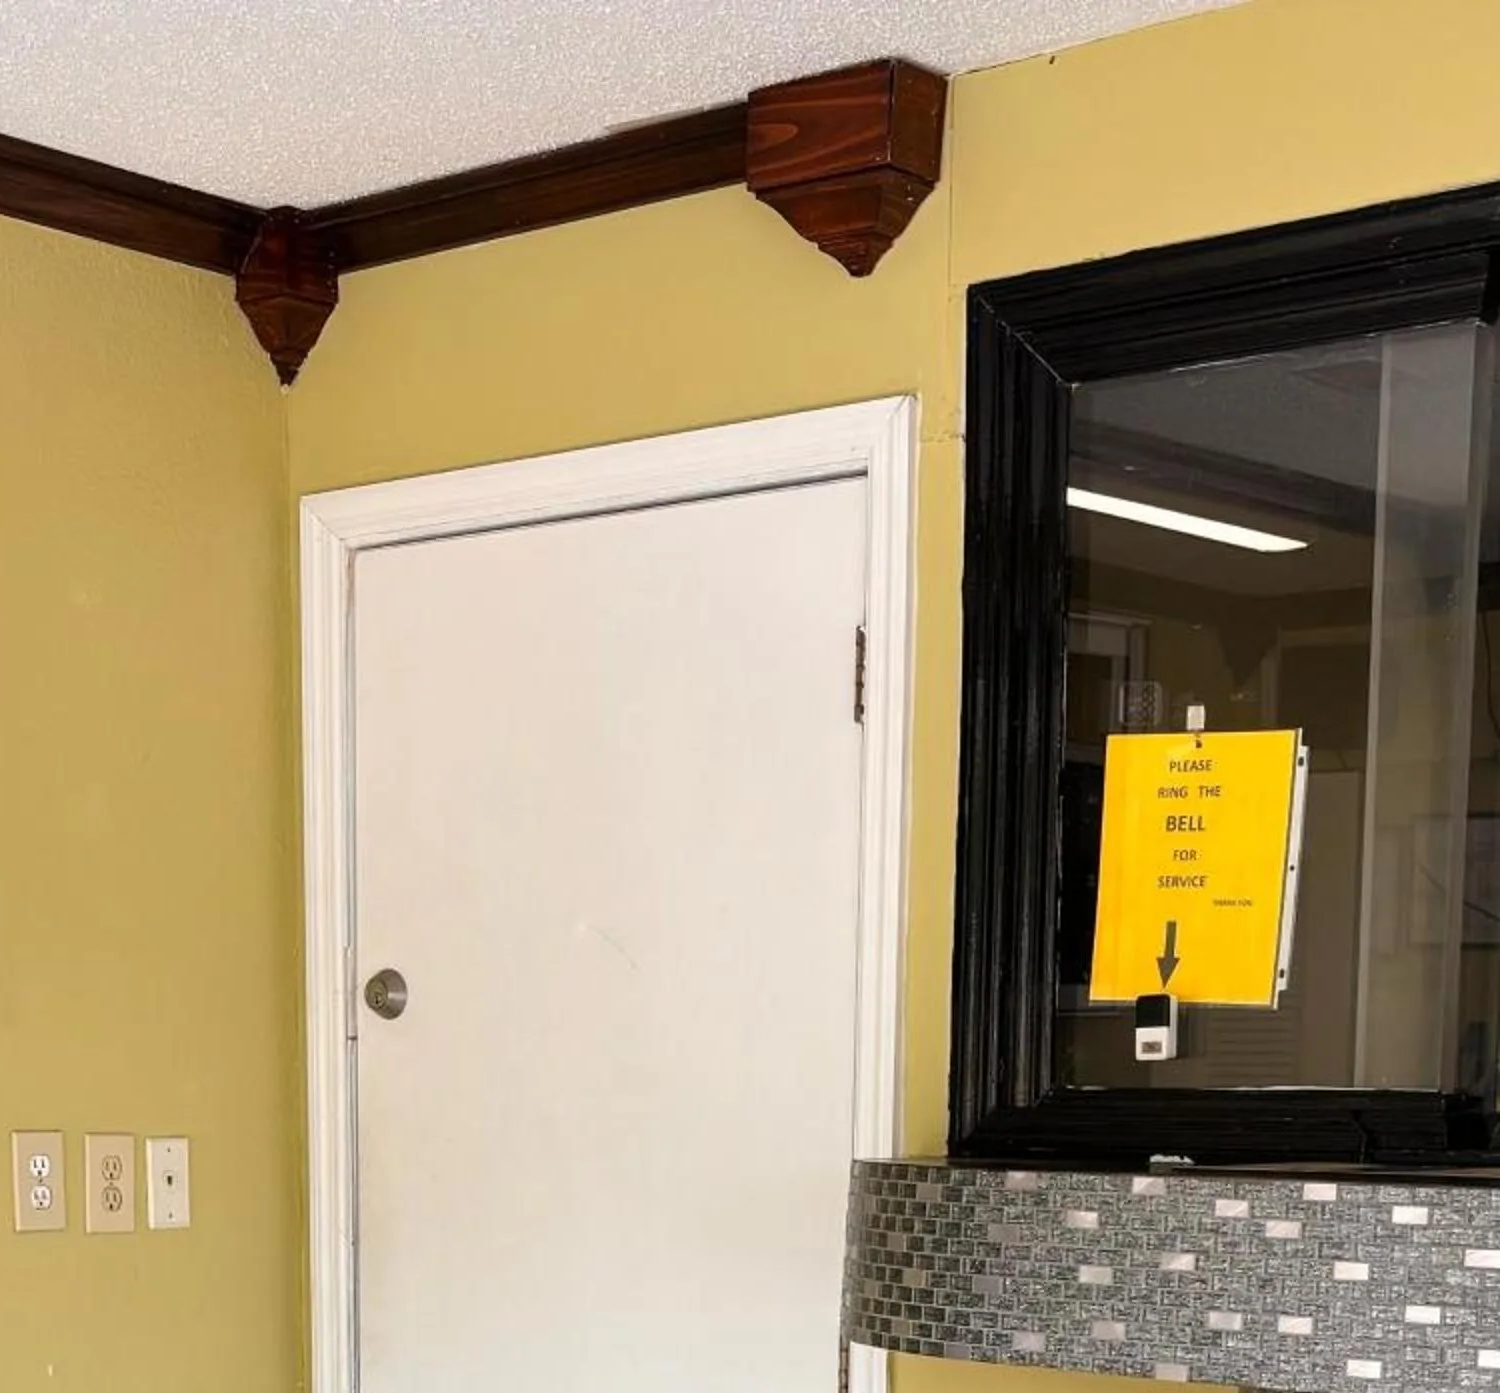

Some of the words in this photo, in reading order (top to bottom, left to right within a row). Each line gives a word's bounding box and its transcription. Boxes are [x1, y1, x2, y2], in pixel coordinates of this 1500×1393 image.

[1169, 759, 1213, 773] PLEASE
[1157, 786, 1189, 799] RING
[1199, 785, 1222, 798] THE
[1165, 815, 1207, 833] BELL
[1173, 849, 1198, 862] FOR
[1157, 875, 1208, 889] SERVICE
